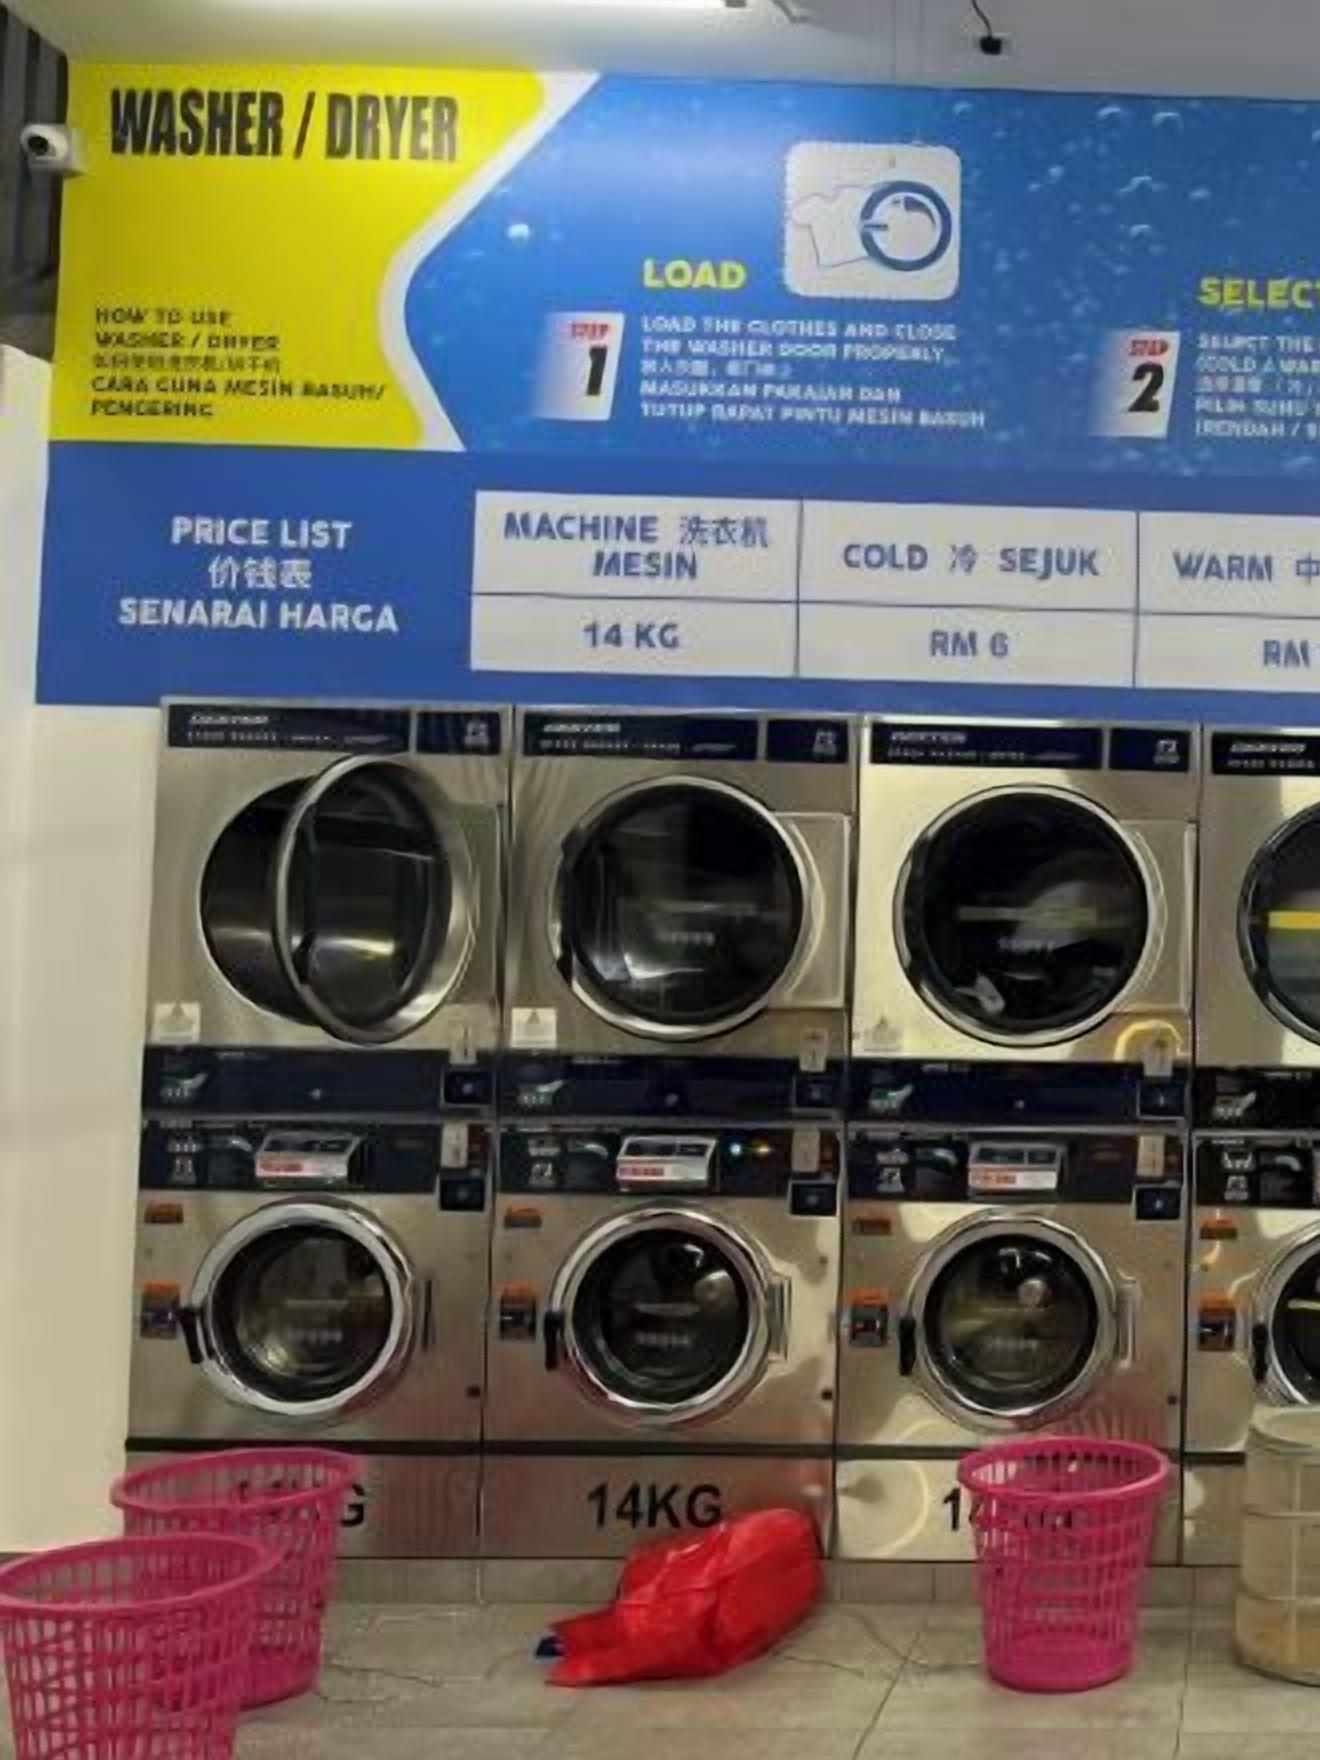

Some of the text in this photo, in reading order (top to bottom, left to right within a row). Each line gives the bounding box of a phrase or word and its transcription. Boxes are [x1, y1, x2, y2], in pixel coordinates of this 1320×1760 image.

[110, 87, 458, 162] WASHER / DRYER
[641, 257, 747, 290] LOAD
[95, 307, 146, 325] HOW
[154, 307, 182, 325] TO
[640, 315, 697, 334] LOAD
[91, 375, 149, 394] CARA
[223, 378, 293, 397] MESIN
[586, 345, 608, 397] 1
[1128, 361, 1164, 412] 2
[171, 515, 353, 550] PRICE LIST
[504, 511, 769, 549] MACHINE 洗衣机
[592, 550, 699, 579] MESIN
[842, 542, 929, 572] COLD
[999, 546, 1099, 580] SEJUK
[1173, 551, 1274, 582] WARM
[119, 596, 400, 633] SENARAI HARGA
[583, 622, 681, 650] 14 KG
[929, 630, 1009, 658] RM 6
[1262, 639, 1310, 668] RM
[587, 1482, 722, 1529] 14KG
